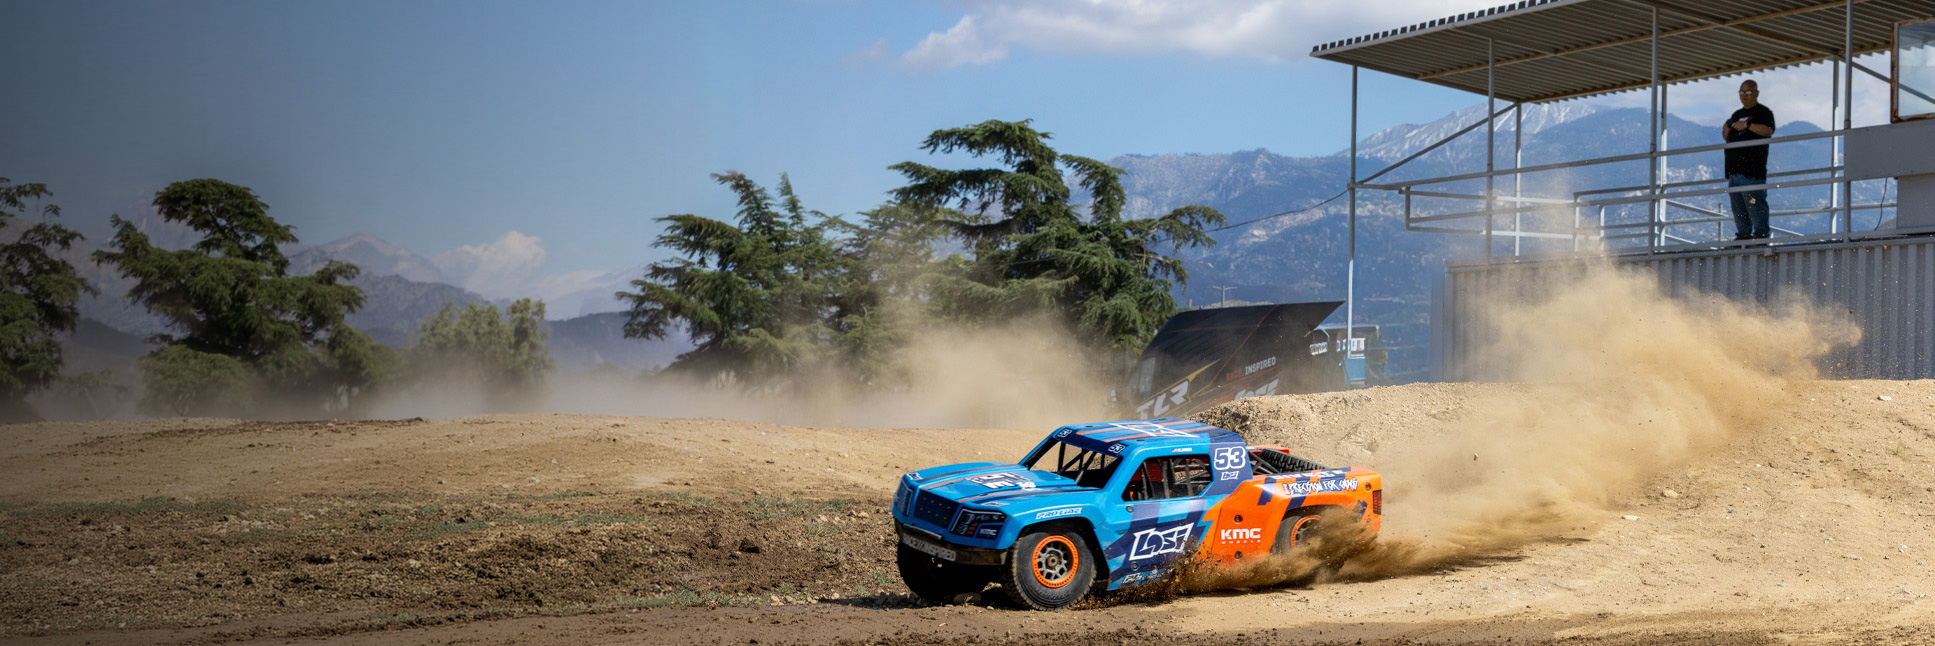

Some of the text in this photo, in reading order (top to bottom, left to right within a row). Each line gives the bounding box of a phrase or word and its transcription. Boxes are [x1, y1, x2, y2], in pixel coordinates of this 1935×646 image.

[1245, 356, 1277, 376] INSPIRED
[1136, 380, 1189, 420] TLR
[1213, 446, 1247, 471] 53
[1322, 479, 1341, 491] FOR
[1220, 528, 1262, 540] KMC
